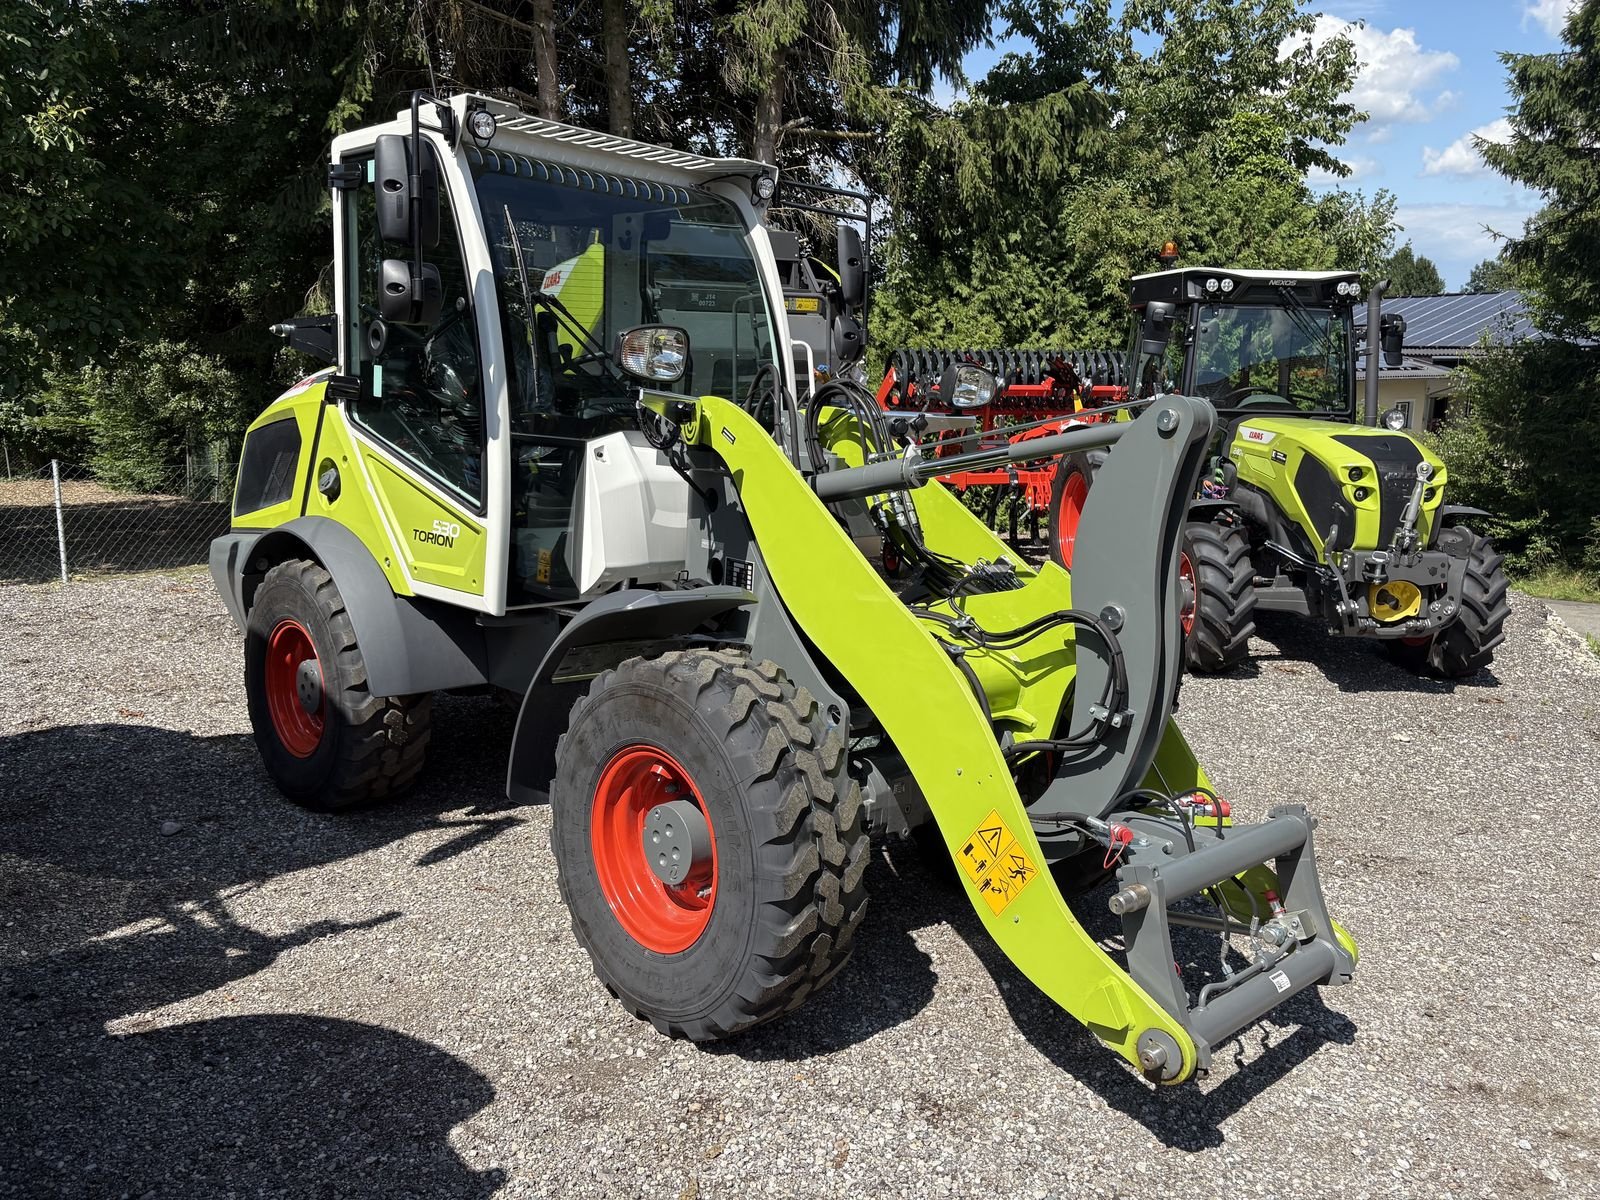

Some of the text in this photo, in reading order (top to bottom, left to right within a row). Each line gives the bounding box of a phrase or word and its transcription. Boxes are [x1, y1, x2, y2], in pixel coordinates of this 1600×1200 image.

[1249, 431, 1264, 440] CLAAS
[412, 528, 454, 549] TORION
[431, 519, 461, 539] 530
